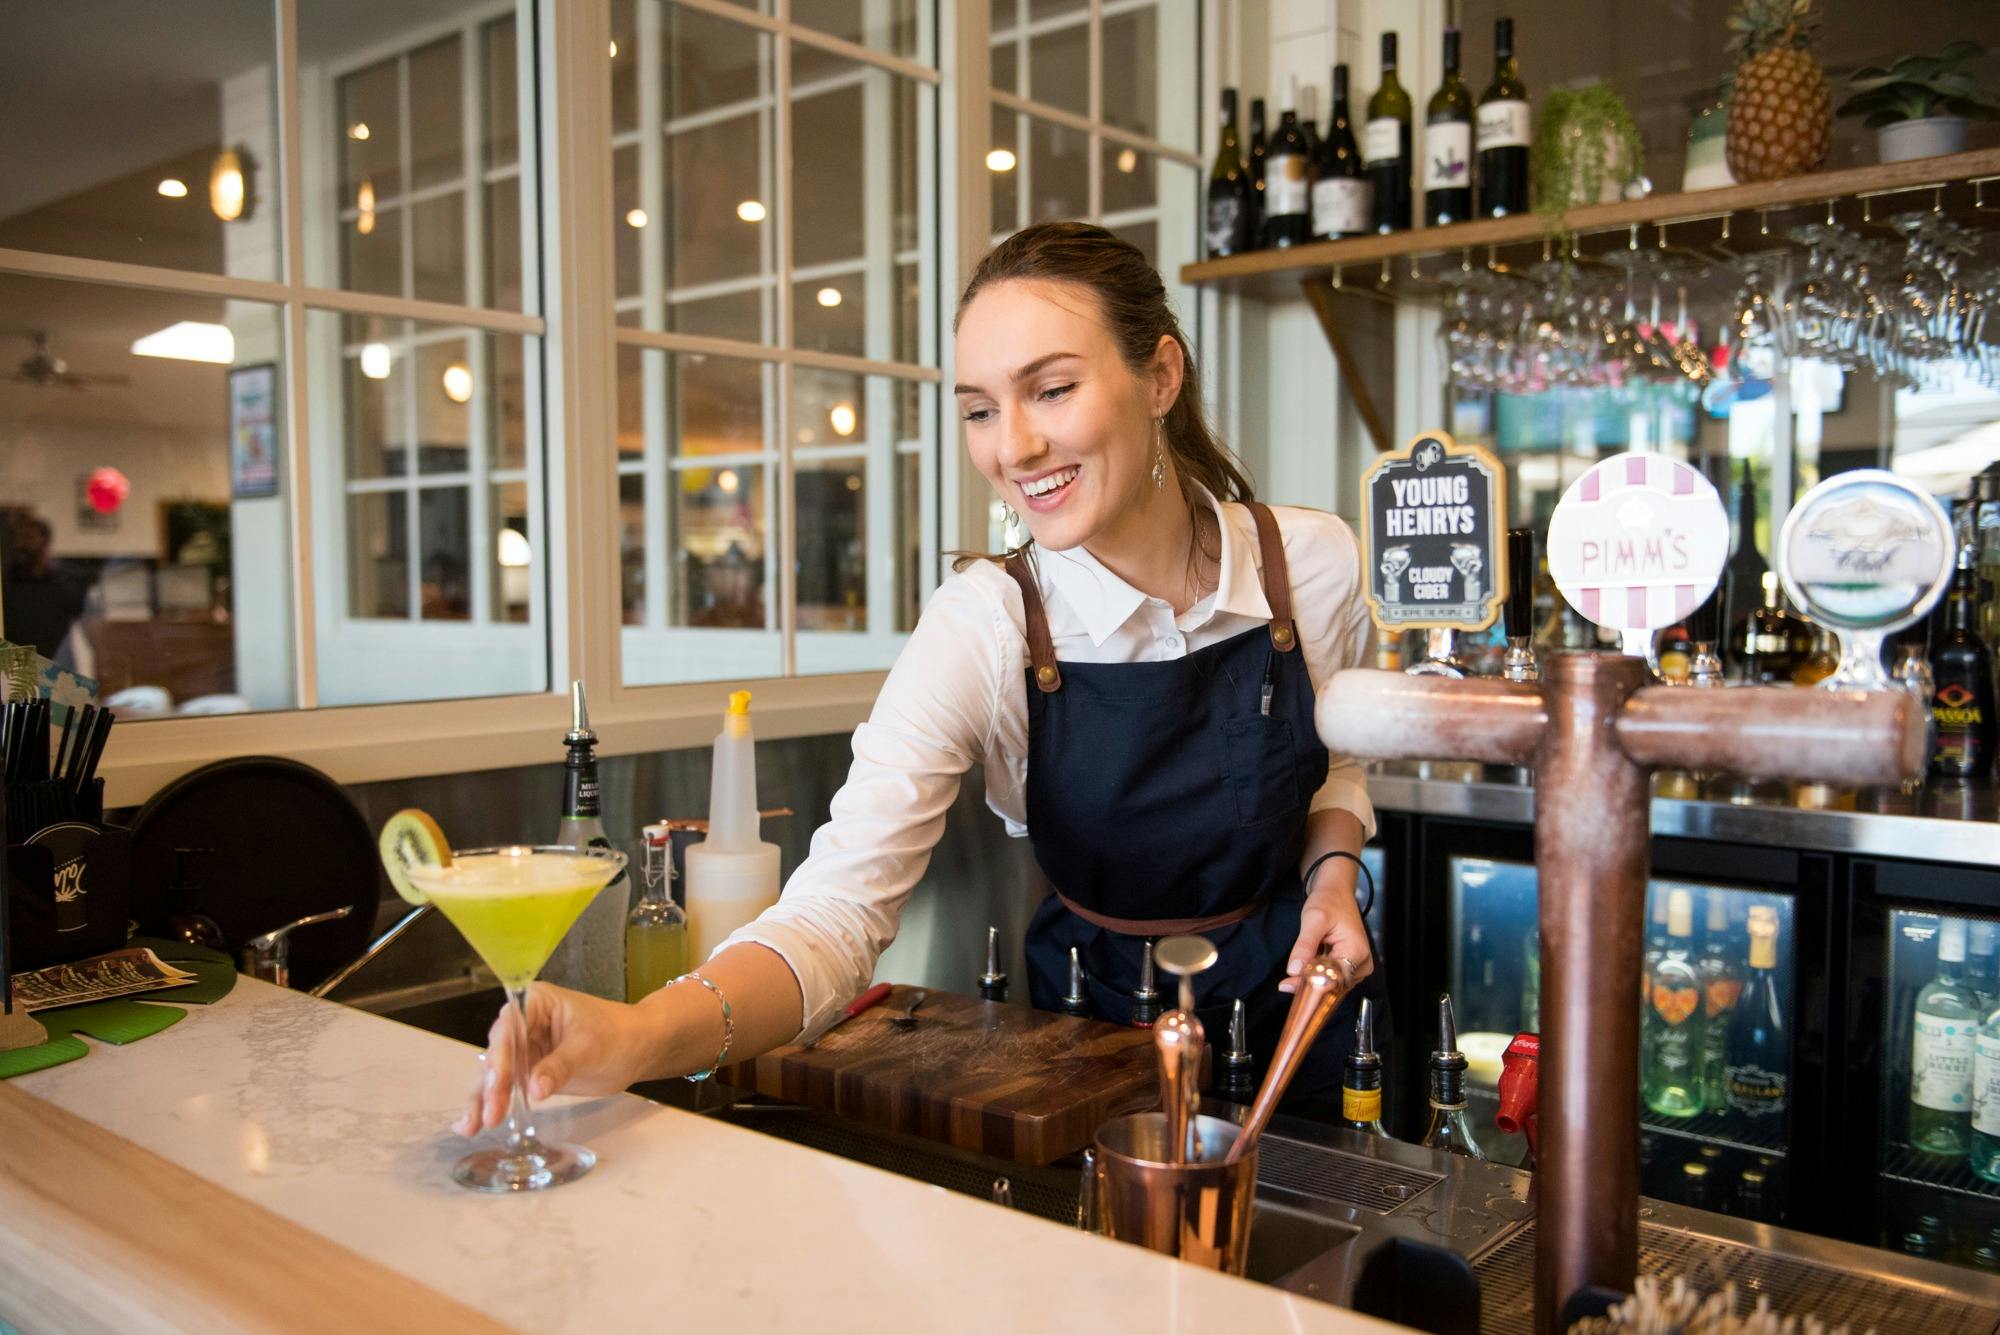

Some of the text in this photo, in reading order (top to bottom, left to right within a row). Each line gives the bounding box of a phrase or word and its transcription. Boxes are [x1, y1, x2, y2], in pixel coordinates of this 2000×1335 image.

[1392, 475, 1469, 507] YOUNG
[1386, 505, 1475, 537] HENRYS
[1408, 566, 1454, 584] CLOUDY
[1413, 583, 1449, 600] CIDER
